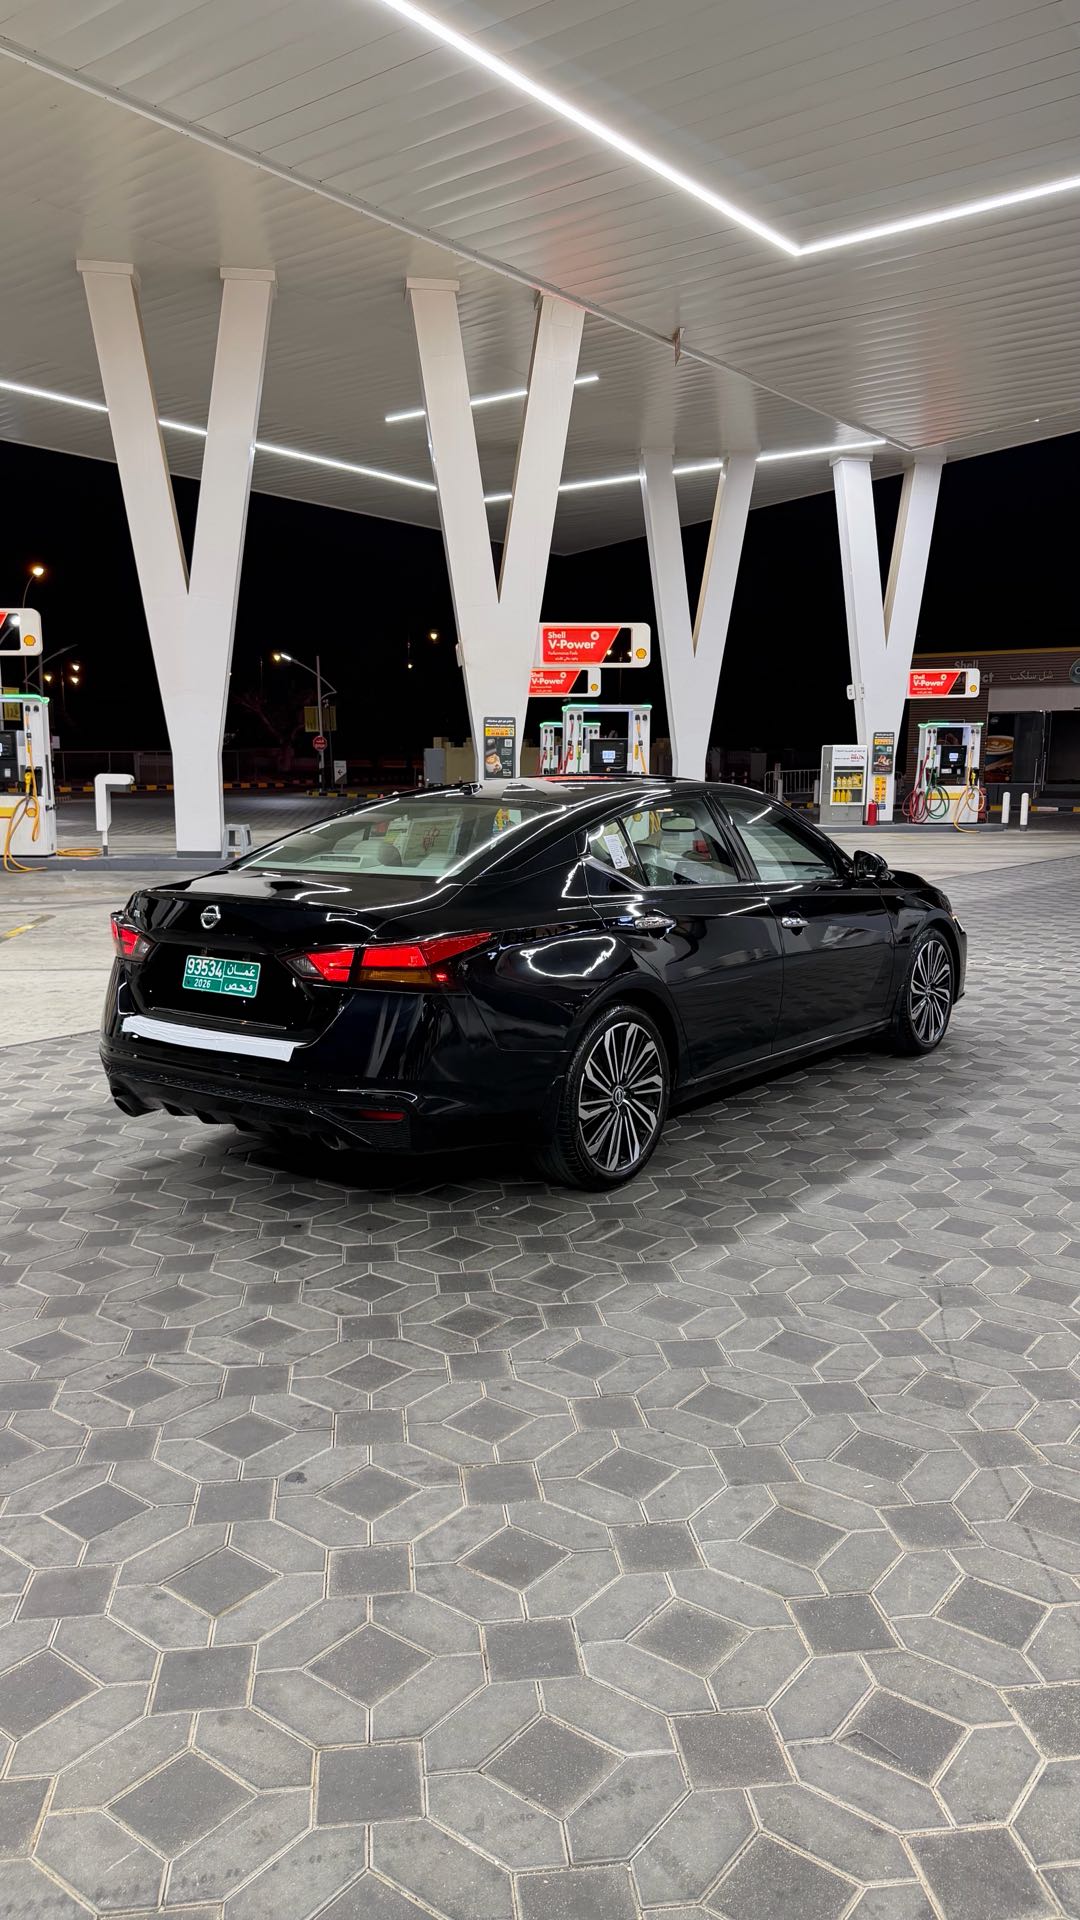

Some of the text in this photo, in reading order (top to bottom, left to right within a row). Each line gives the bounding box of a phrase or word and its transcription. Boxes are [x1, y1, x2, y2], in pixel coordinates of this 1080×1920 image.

[547, 631, 566, 639] Shell
[548, 639, 596, 649] V-Power
[531, 677, 565, 685] V-Power
[187, 958, 223, 978] 93534
[194, 978, 212, 989] 2026
[224, 981, 254, 993] فحص
